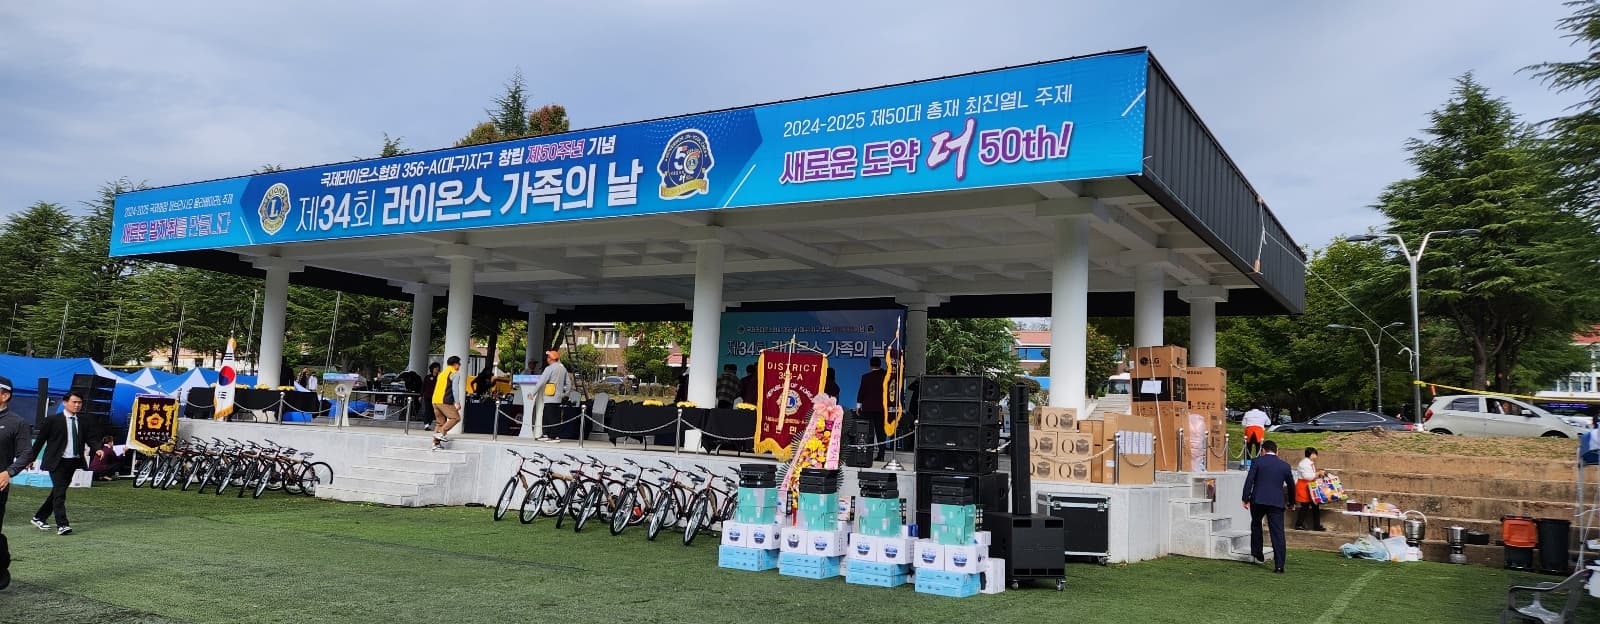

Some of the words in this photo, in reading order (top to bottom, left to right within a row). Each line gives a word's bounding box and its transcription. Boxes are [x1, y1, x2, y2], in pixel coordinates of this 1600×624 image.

[784, 112, 865, 137] 2024-2025
[870, 104, 922, 127] 제50대
[926, 98, 960, 120] 총재
[964, 91, 1029, 115] 최진열L
[1034, 84, 1073, 106] 주제
[320, 163, 401, 187] 국제라이온스협회
[402, 152, 493, 179] 356-A(대구)지구
[498, 147, 524, 166] 창립
[526, 138, 586, 163] 제50주년
[587, 134, 617, 156] 기념
[779, 145, 858, 185] 새로운
[861, 137, 921, 177] 도약
[926, 117, 977, 181] 더
[978, 121, 1074, 165] 50th!
[296, 189, 376, 232] 제34회
[382, 177, 492, 225] 라이온스
[500, 163, 597, 215] 가족의
[607, 159, 644, 207] 날
[121, 221, 148, 243] 새로운
[827, 340, 867, 357] 가족의
[872, 340, 888, 358] 날
[767, 361, 818, 372] DISTRICT
[1046, 413, 1058, 428] Q
[1061, 439, 1074, 453] Q
[1059, 463, 1072, 478] Q
